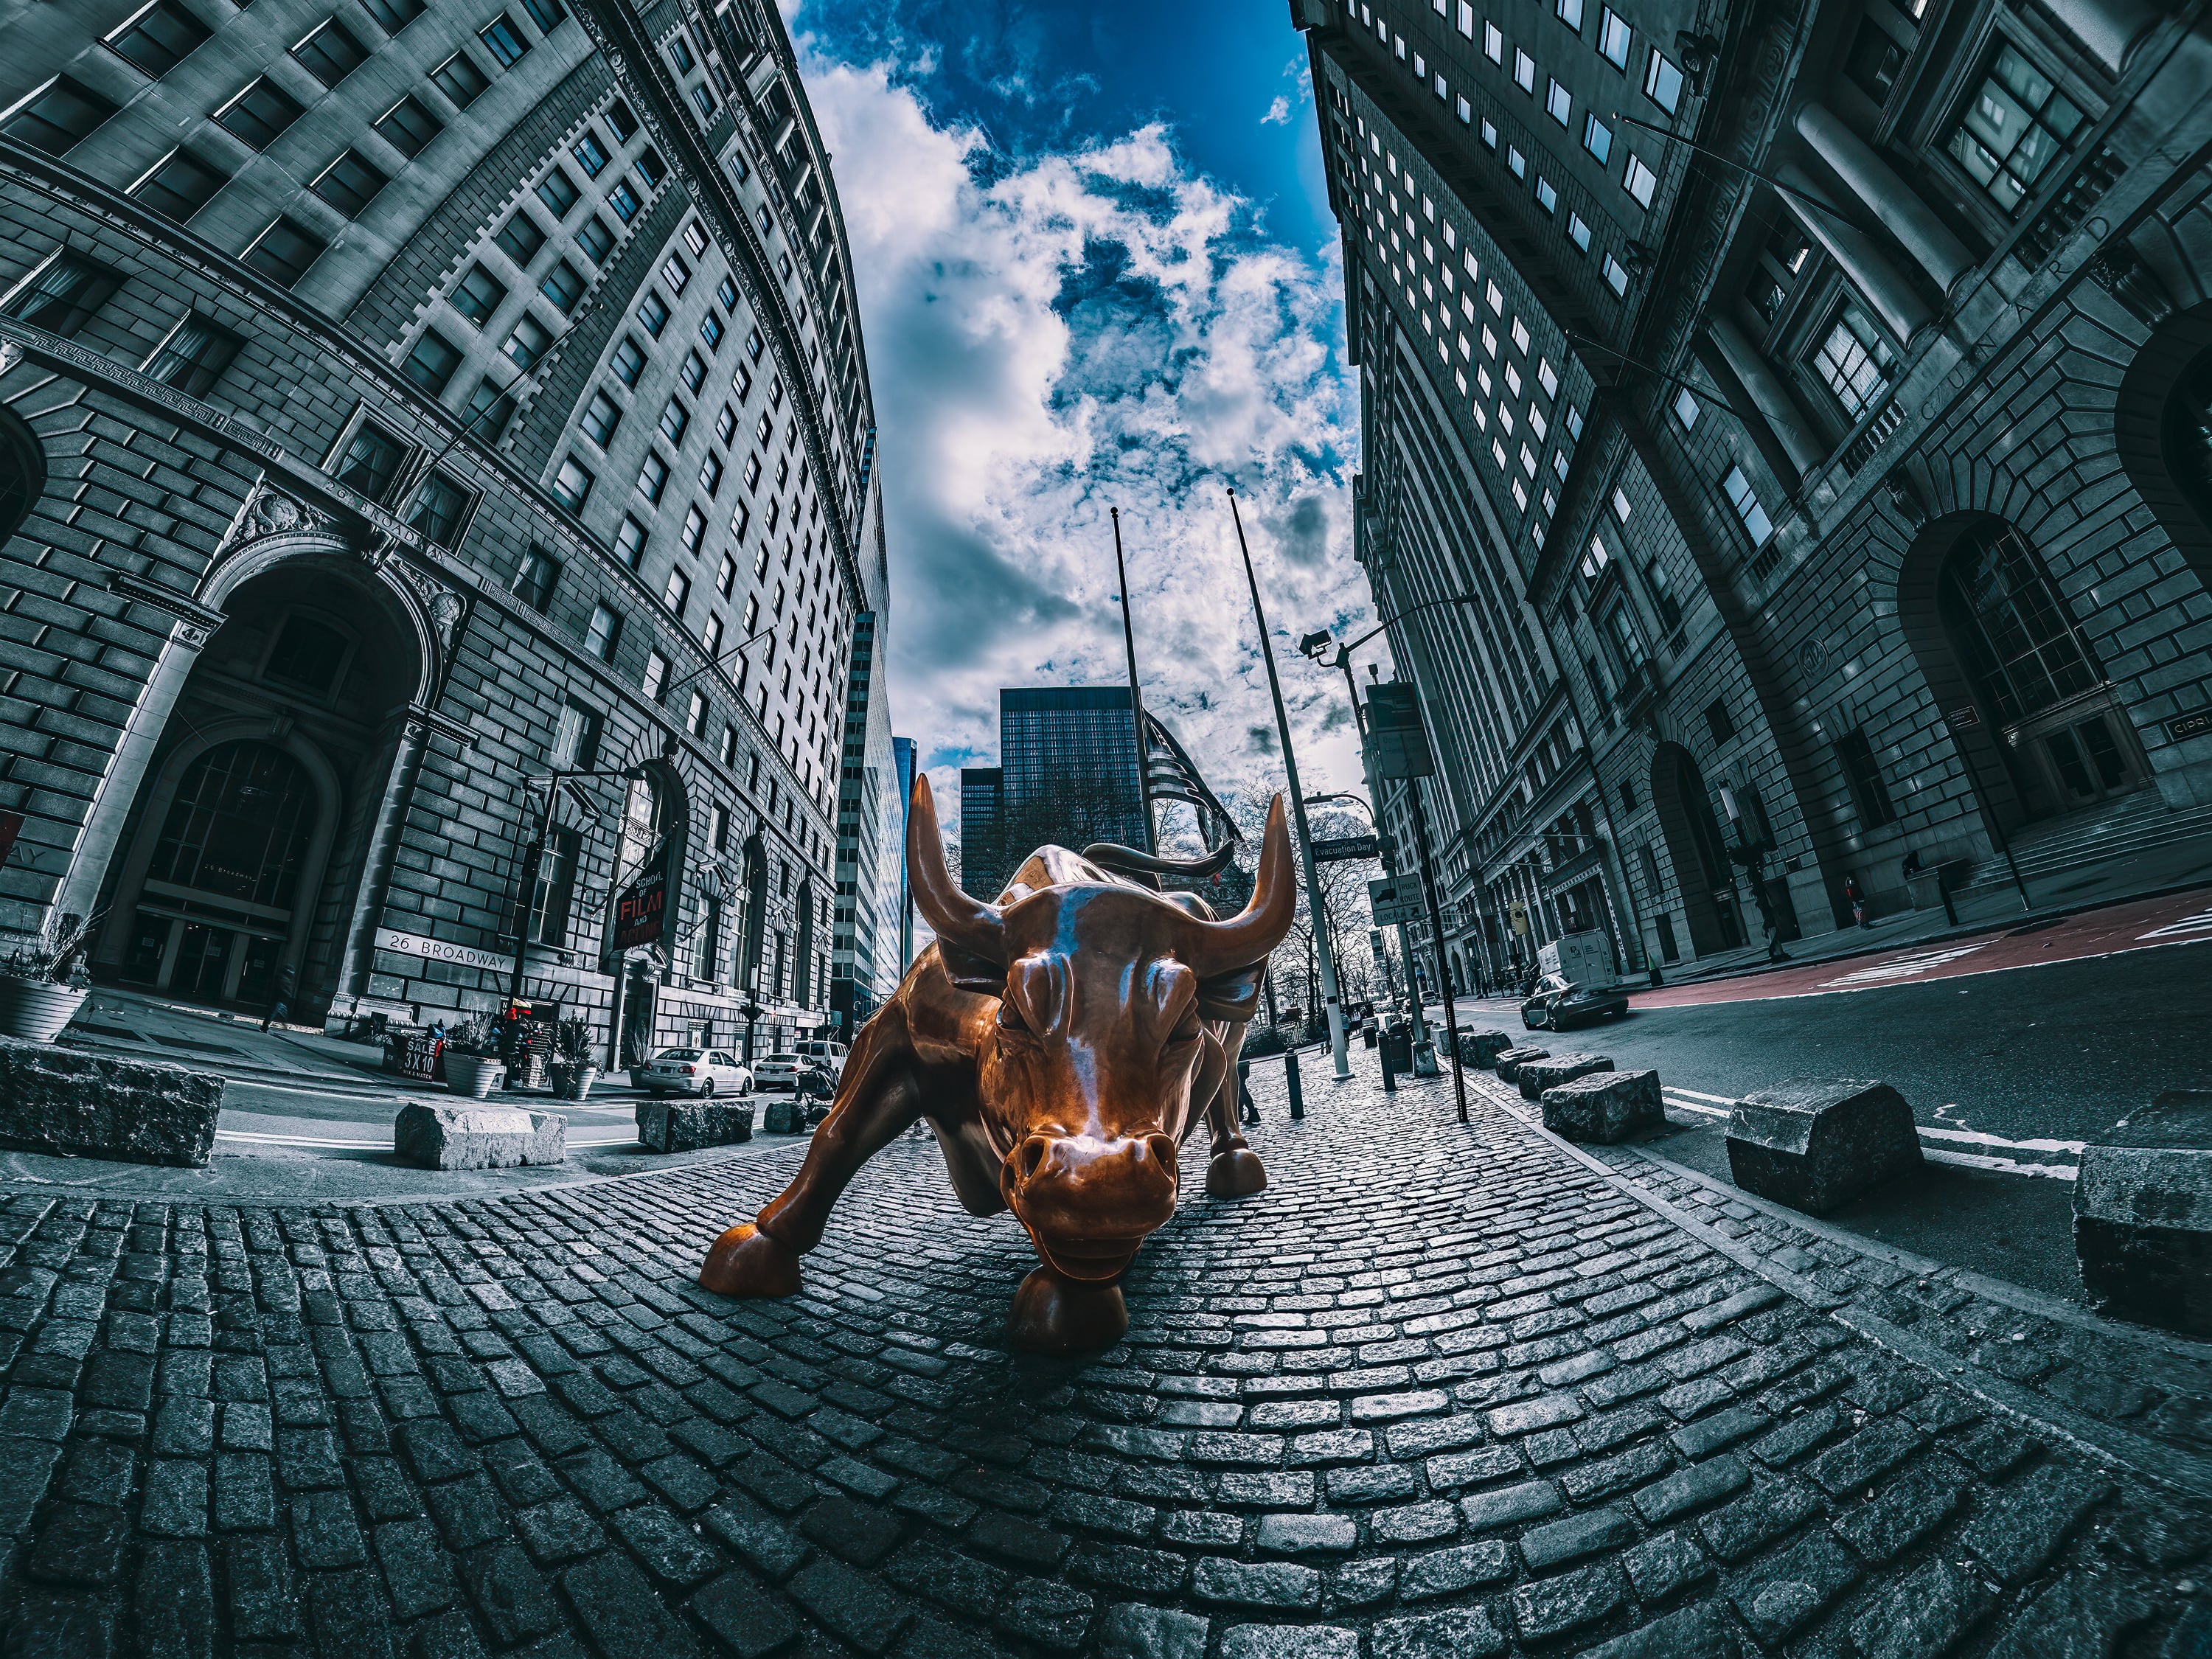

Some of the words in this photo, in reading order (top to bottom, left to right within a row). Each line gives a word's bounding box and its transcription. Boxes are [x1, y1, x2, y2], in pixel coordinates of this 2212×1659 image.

[1921, 217, 2110, 420] CUNARD
[326, 480, 347, 499] 26
[358, 501, 449, 563] BROADWAY
[2174, 716, 2212, 733] CIPRI
[1315, 844, 1357, 856] Evacuation
[1357, 843, 1371, 852] Day
[639, 888, 647, 897] OF
[1399, 893, 1420, 903] ROUTE
[620, 890, 663, 921] FILM
[634, 915, 647, 927] AND
[1380, 911, 1402, 922] LOCAL
[389, 935, 410, 950] 26
[421, 941, 507, 969] BROADWAY
[406, 1040, 437, 1056] SALE
[404, 1051, 412, 1068] 3
[422, 1055, 434, 1073] 10
